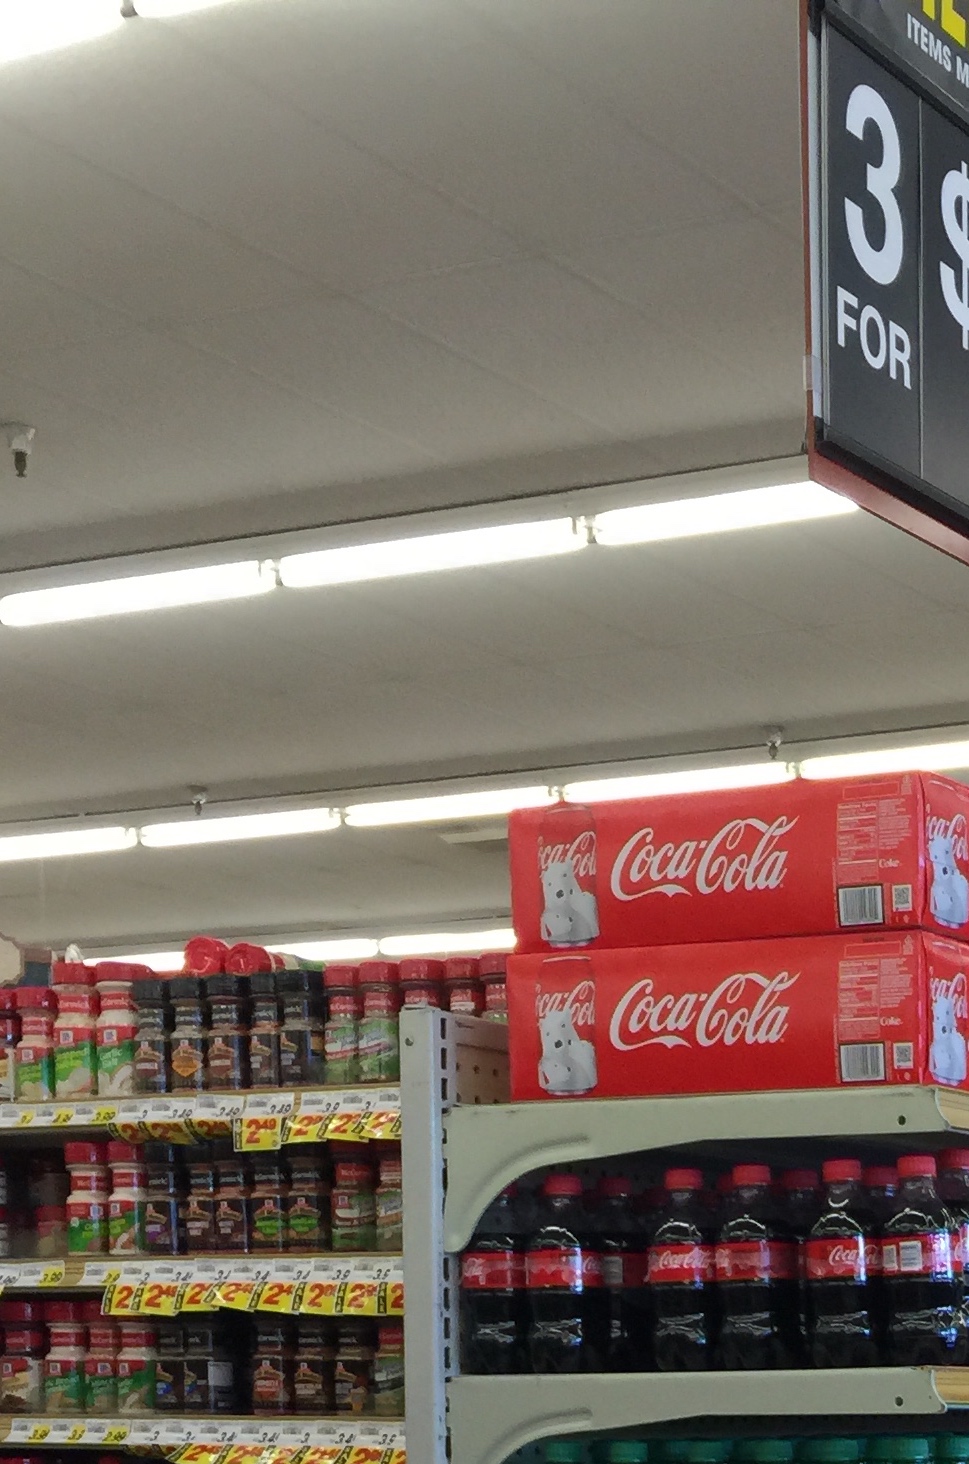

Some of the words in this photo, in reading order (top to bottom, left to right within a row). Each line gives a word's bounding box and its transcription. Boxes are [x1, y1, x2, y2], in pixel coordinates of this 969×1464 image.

[907, 12, 952, 72] ITEMS
[845, 84, 903, 286] 3
[836, 284, 911, 390] FOR
[610, 815, 799, 900] Coca-Cola
[610, 971, 800, 1051] Coca-Cola
